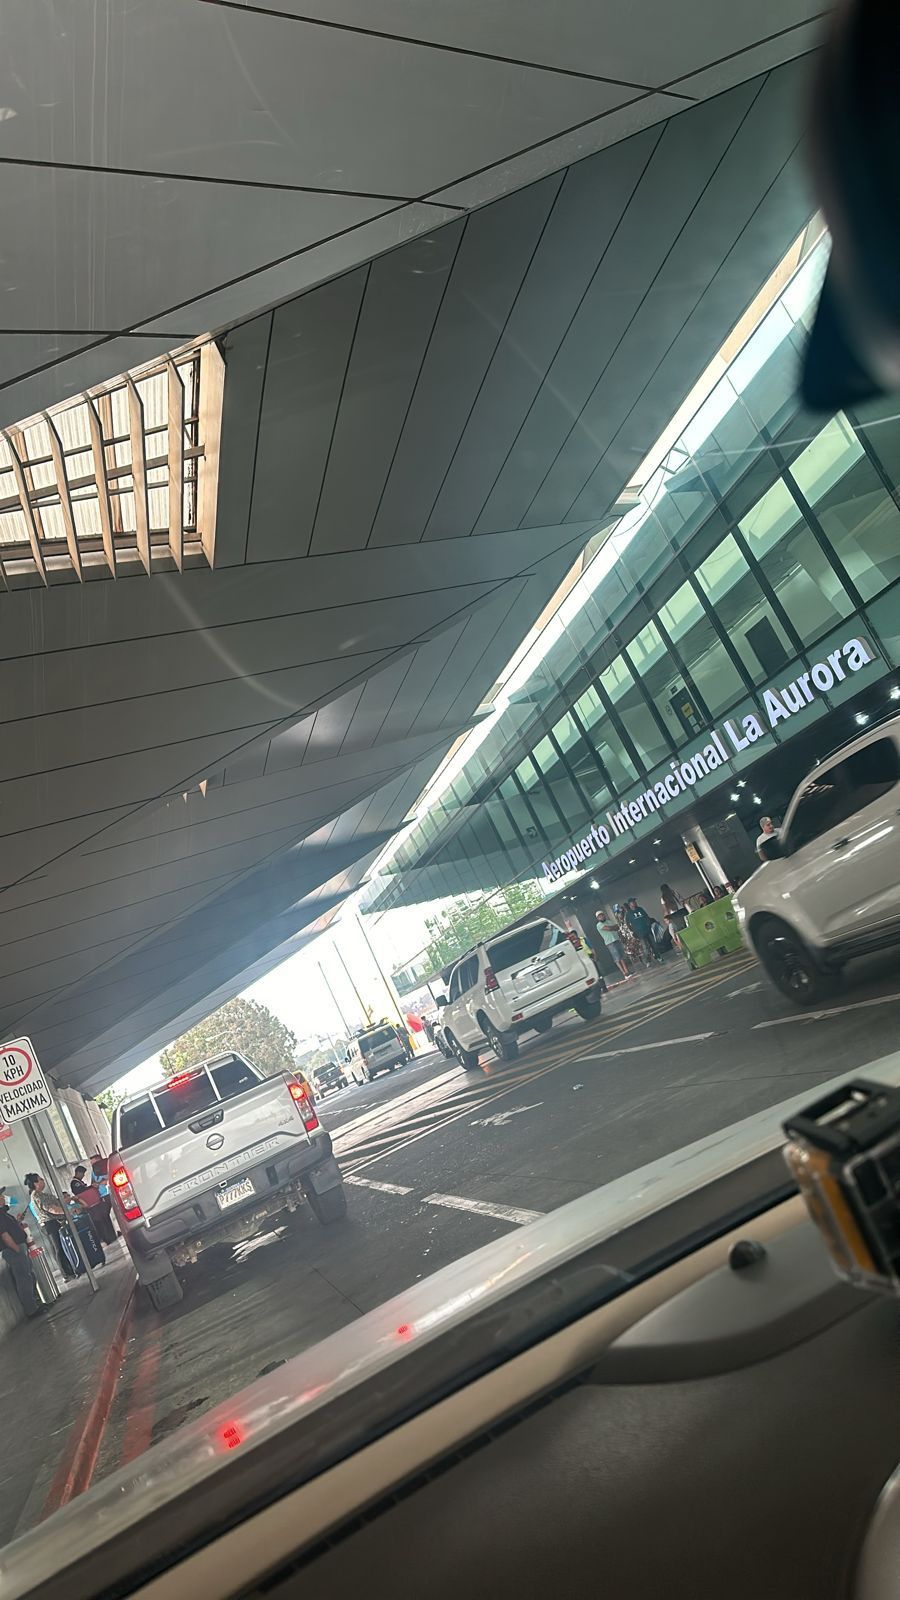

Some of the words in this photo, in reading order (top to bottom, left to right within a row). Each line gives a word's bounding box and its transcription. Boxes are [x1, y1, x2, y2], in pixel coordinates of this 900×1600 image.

[542, 824, 611, 882] Aeropuerto
[606, 732, 729, 837] Internacional
[723, 714, 765, 752] La
[762, 638, 872, 728] Aurora
[3, 1055, 16, 1068] 10
[3, 1065, 24, 1081] KPH
[3, 1093, 47, 1118] MAXIMA
[168, 1137, 280, 1197] FRONTIER
